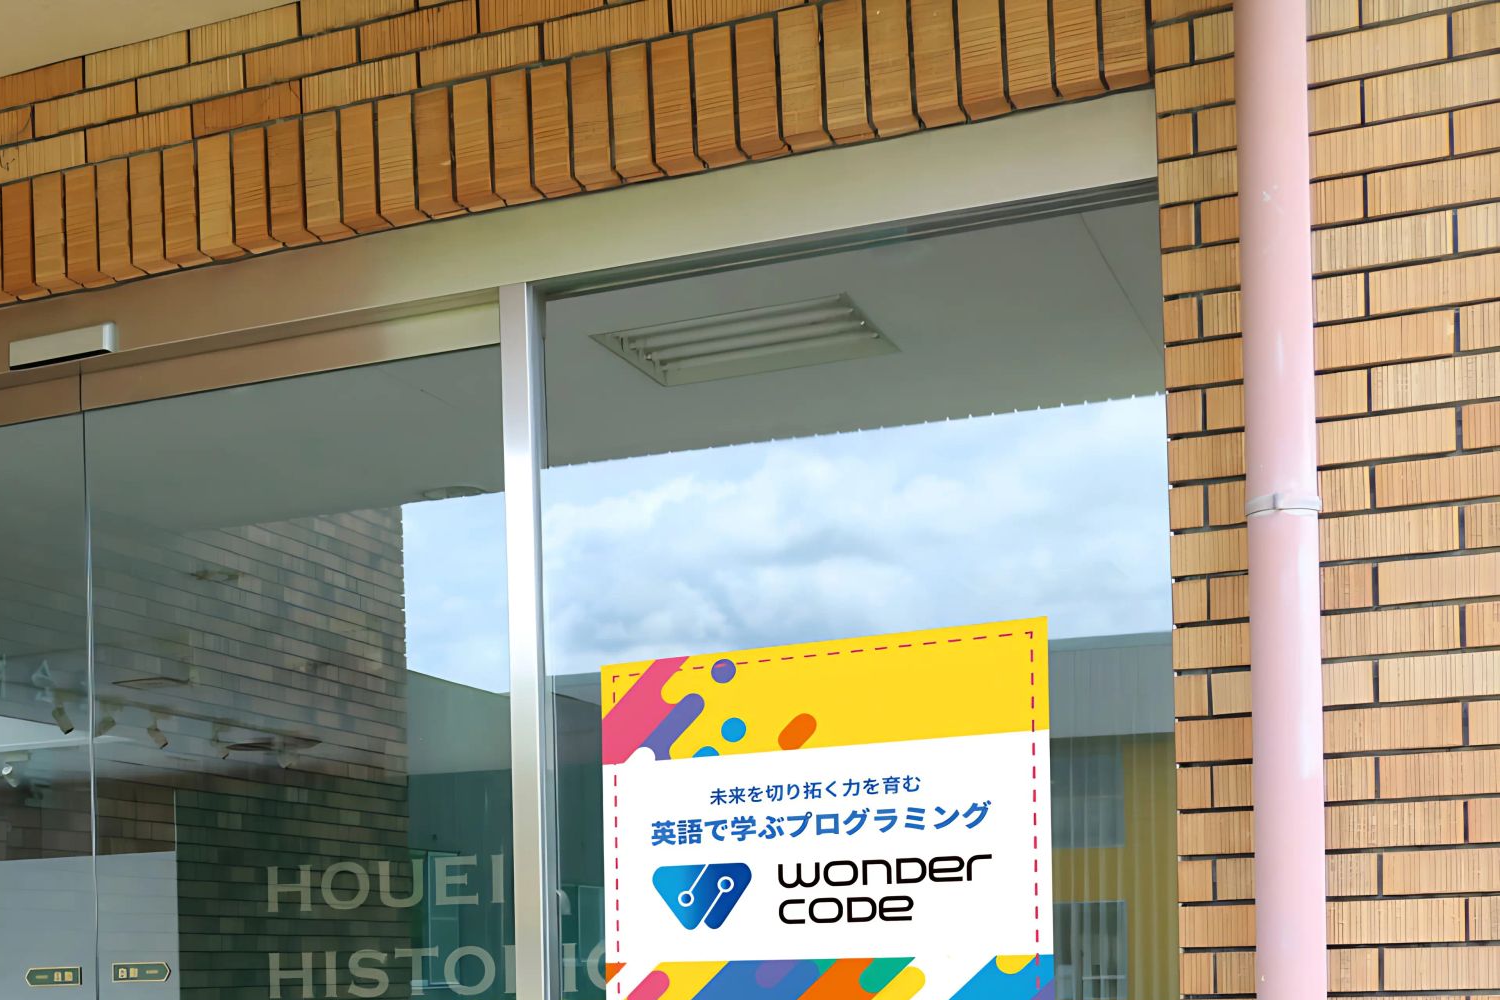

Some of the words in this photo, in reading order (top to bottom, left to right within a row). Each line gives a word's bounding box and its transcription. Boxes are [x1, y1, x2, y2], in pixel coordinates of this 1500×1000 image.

[710, 774, 921, 806] 未来を切り拓く力を育む
[651, 800, 992, 846] 英語で学ぶプログラミング
[267, 853, 505, 913] HOUEI
